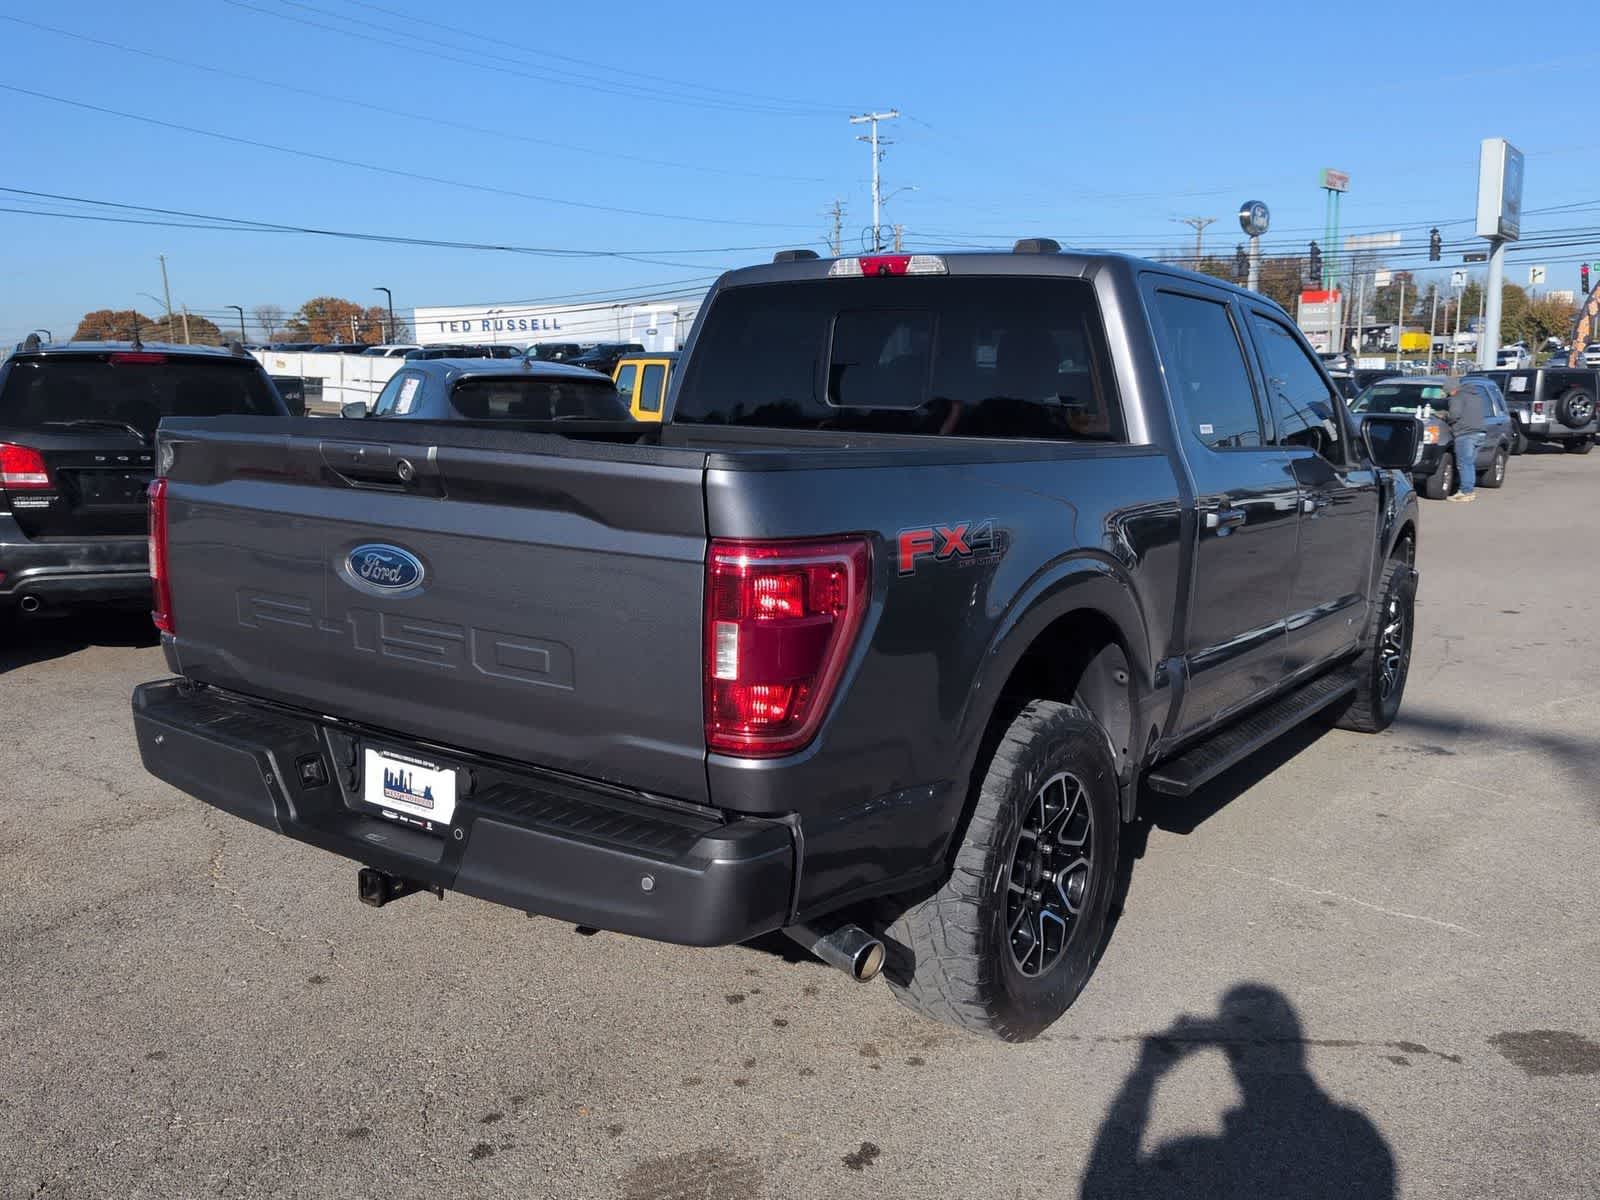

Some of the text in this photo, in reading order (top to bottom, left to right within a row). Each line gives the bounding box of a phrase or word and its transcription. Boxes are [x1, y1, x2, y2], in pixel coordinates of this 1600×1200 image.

[439, 318, 562, 333] TED RUSSELL
[360, 552, 403, 585] Ford
[896, 517, 1002, 577] FX4
[235, 588, 576, 691] F-150
